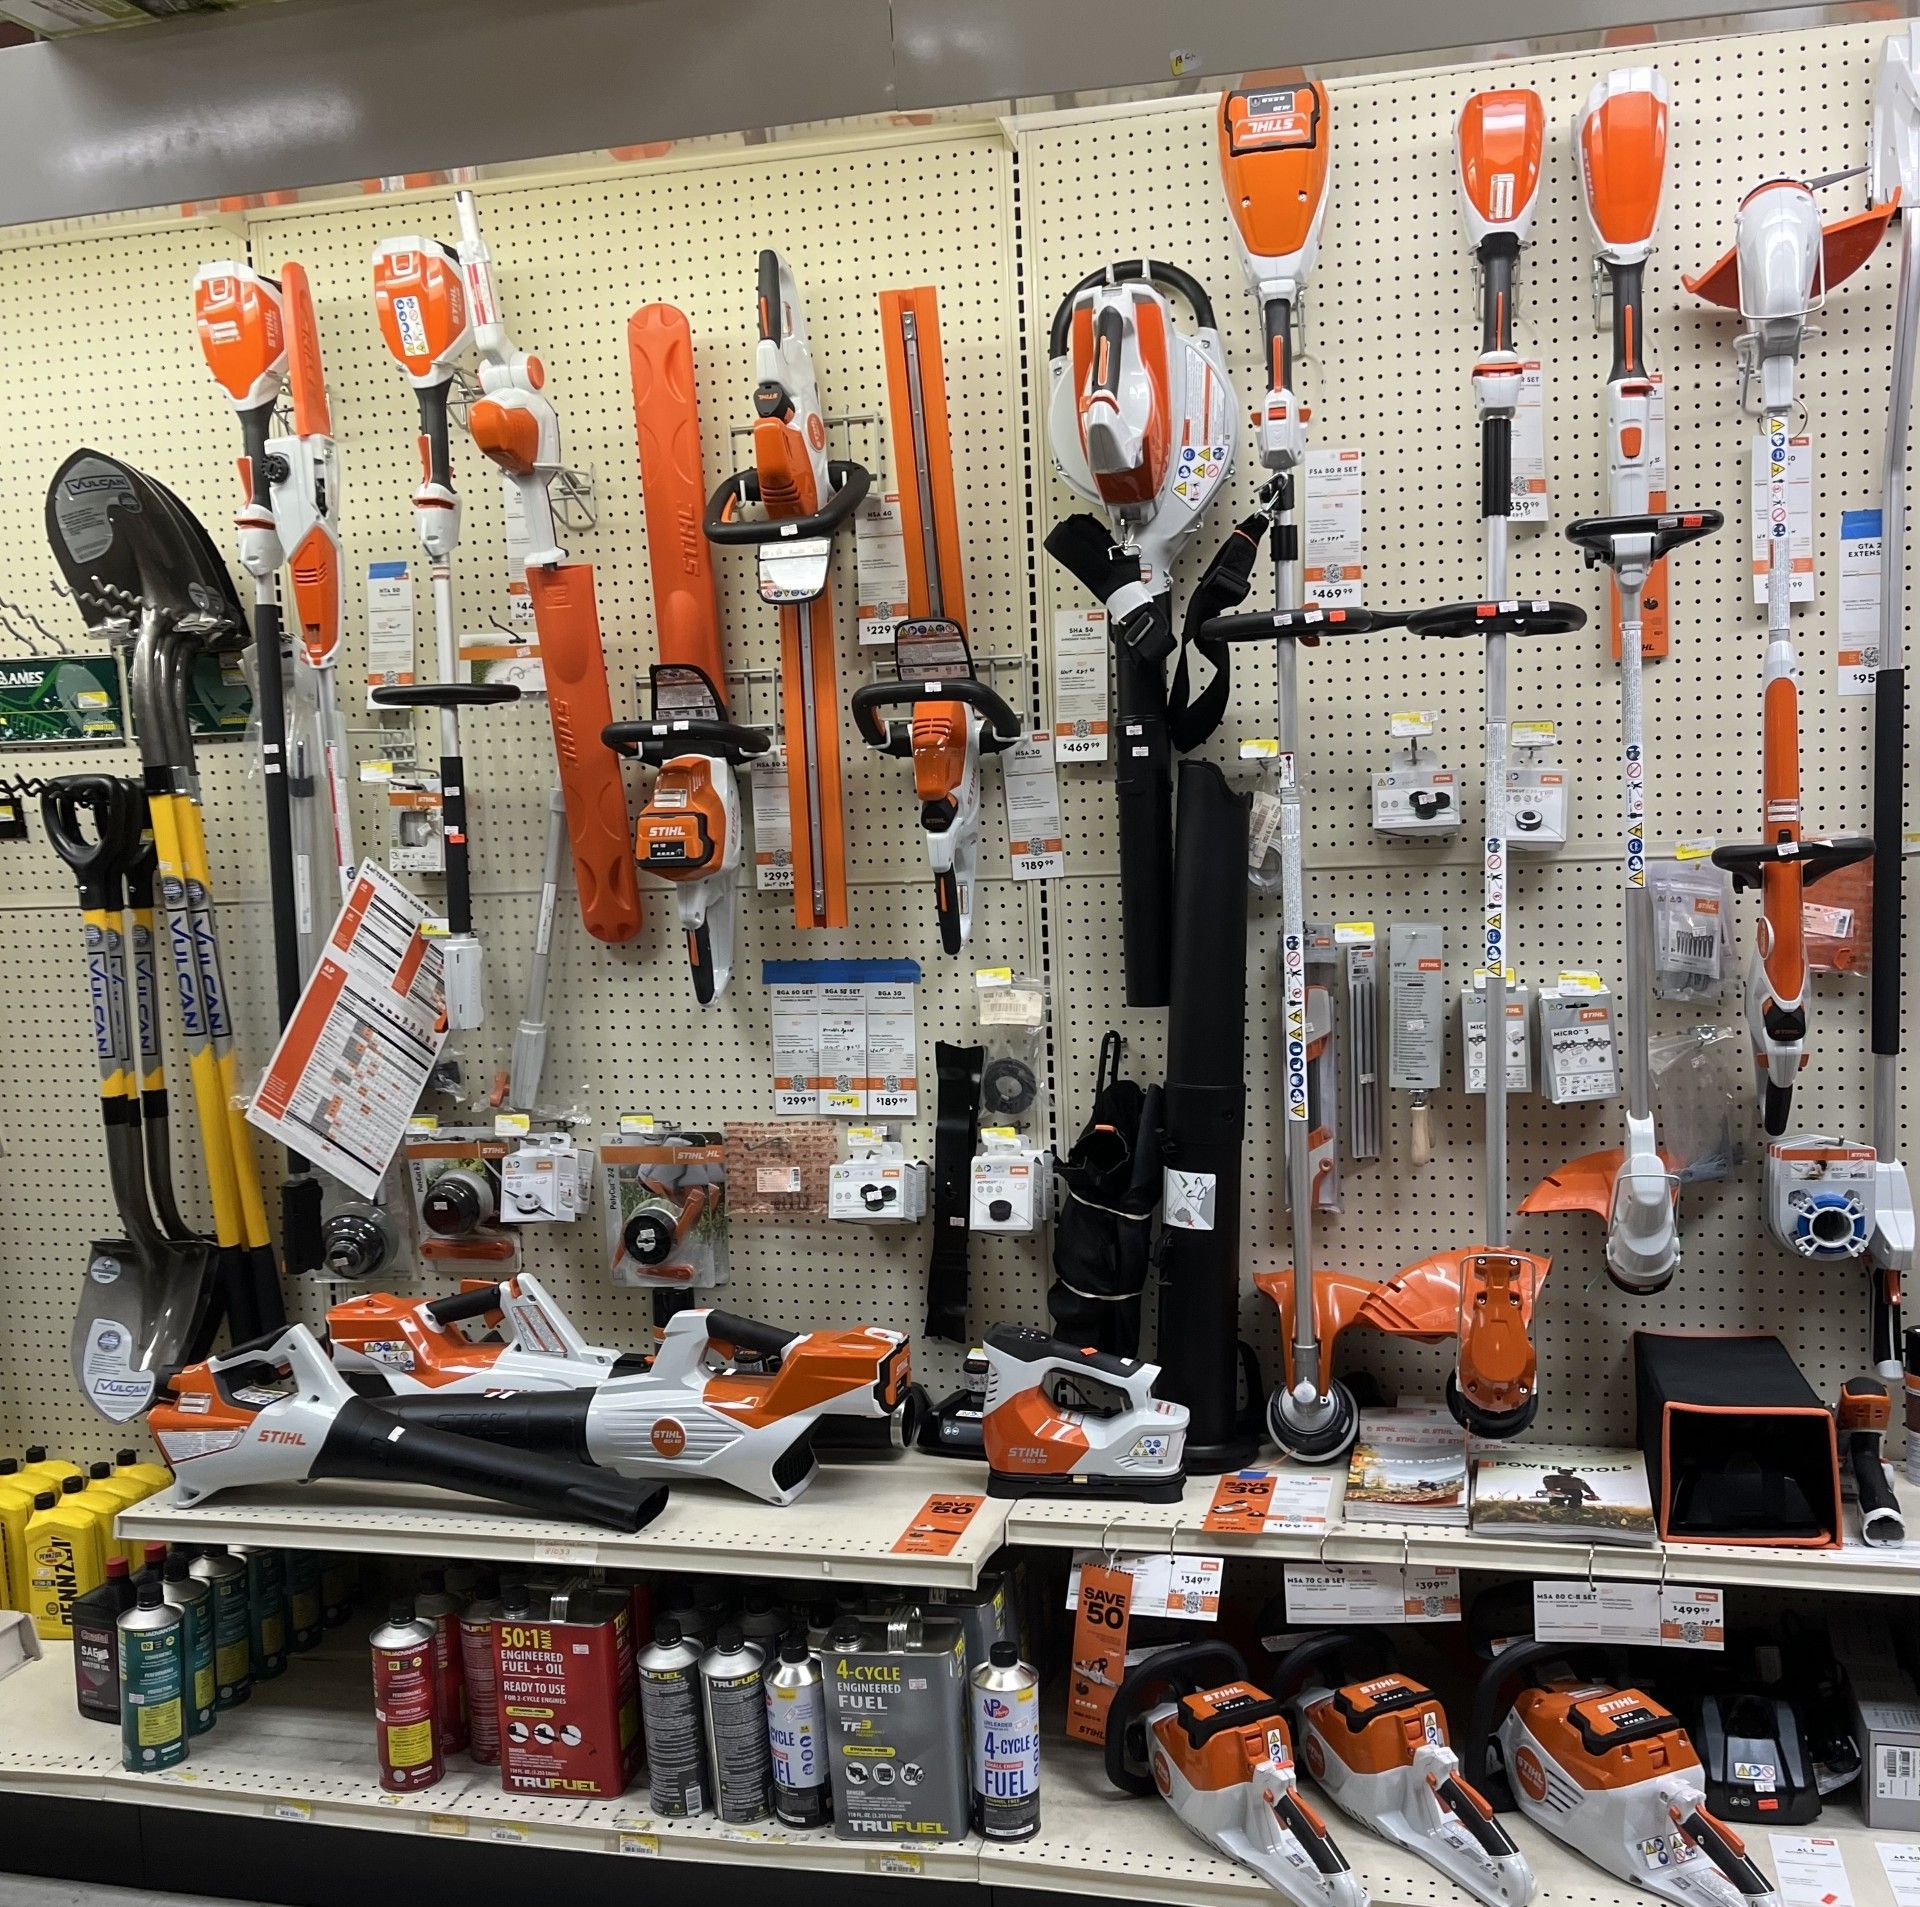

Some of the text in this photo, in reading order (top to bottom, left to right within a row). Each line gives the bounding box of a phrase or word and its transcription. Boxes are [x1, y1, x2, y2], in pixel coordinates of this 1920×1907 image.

[1248, 117, 1295, 134] STIHL
[449, 286, 461, 325] STIHL
[268, 308, 278, 348] STIHL
[1309, 467, 1323, 475] FSA
[70, 475, 128, 491] VULCAN
[677, 503, 700, 577] STIHL
[1848, 550, 1881, 558] EXTENS
[516, 602, 534, 610] $44
[9, 671, 45, 685] AMES
[1853, 672, 1876, 685] $95
[648, 825, 686, 838] STIHL
[169, 915, 199, 1030] VULCAN
[1420, 961, 1440, 969] STIHL
[89, 958, 109, 1053] VULCAN
[1582, 1011, 1606, 1019] STIHL
[482, 1146, 506, 1155] STIHL
[677, 1150, 705, 1160] STIHL
[99, 1379, 149, 1398] VULCAN
[258, 1429, 307, 1446] STIHL
[653, 1430, 682, 1439] STIHL
[1007, 1447, 1048, 1459] STIHL
[1417, 1453, 1462, 1465] TOOLS
[1495, 1461, 1633, 1474] POWER TOOLS
[929, 1500, 976, 1509] SAVE
[1083, 1587, 1126, 1607] SAVE
[501, 1626, 552, 1650] 50:1 MIX
[81, 1645, 98, 1658] SAE
[501, 1650, 564, 1663] ENGINEERED
[82, 1660, 101, 1670] MOTOR
[502, 1661, 531, 1673] FUEL
[545, 1663, 565, 1676] OIL
[836, 1658, 901, 1681] 4-CYCLE
[711, 1671, 761, 1688] TRUFUEL
[1359, 1676, 1401, 1695] STIHL
[503, 1680, 566, 1695] READY TO USE
[837, 1682, 902, 1694] ENGINEERED
[1202, 1684, 1244, 1704] STIHL
[541, 1697, 567, 1705] ENGINES
[838, 1694, 888, 1710] FUEL
[983, 1698, 1001, 1718] VP
[1597, 1696, 1640, 1714] STIHL
[983, 1720, 1013, 1728] UNLEADED
[1078, 1725, 1106, 1740] STIHL
[984, 1731, 1031, 1761] 4-CYCLE
[1516, 1757, 1546, 1785] STIHL
[510, 1775, 602, 1793] TRUFUEL
[984, 1769, 1029, 1798] FUEL
[848, 1819, 949, 1835] TRUFUEL
